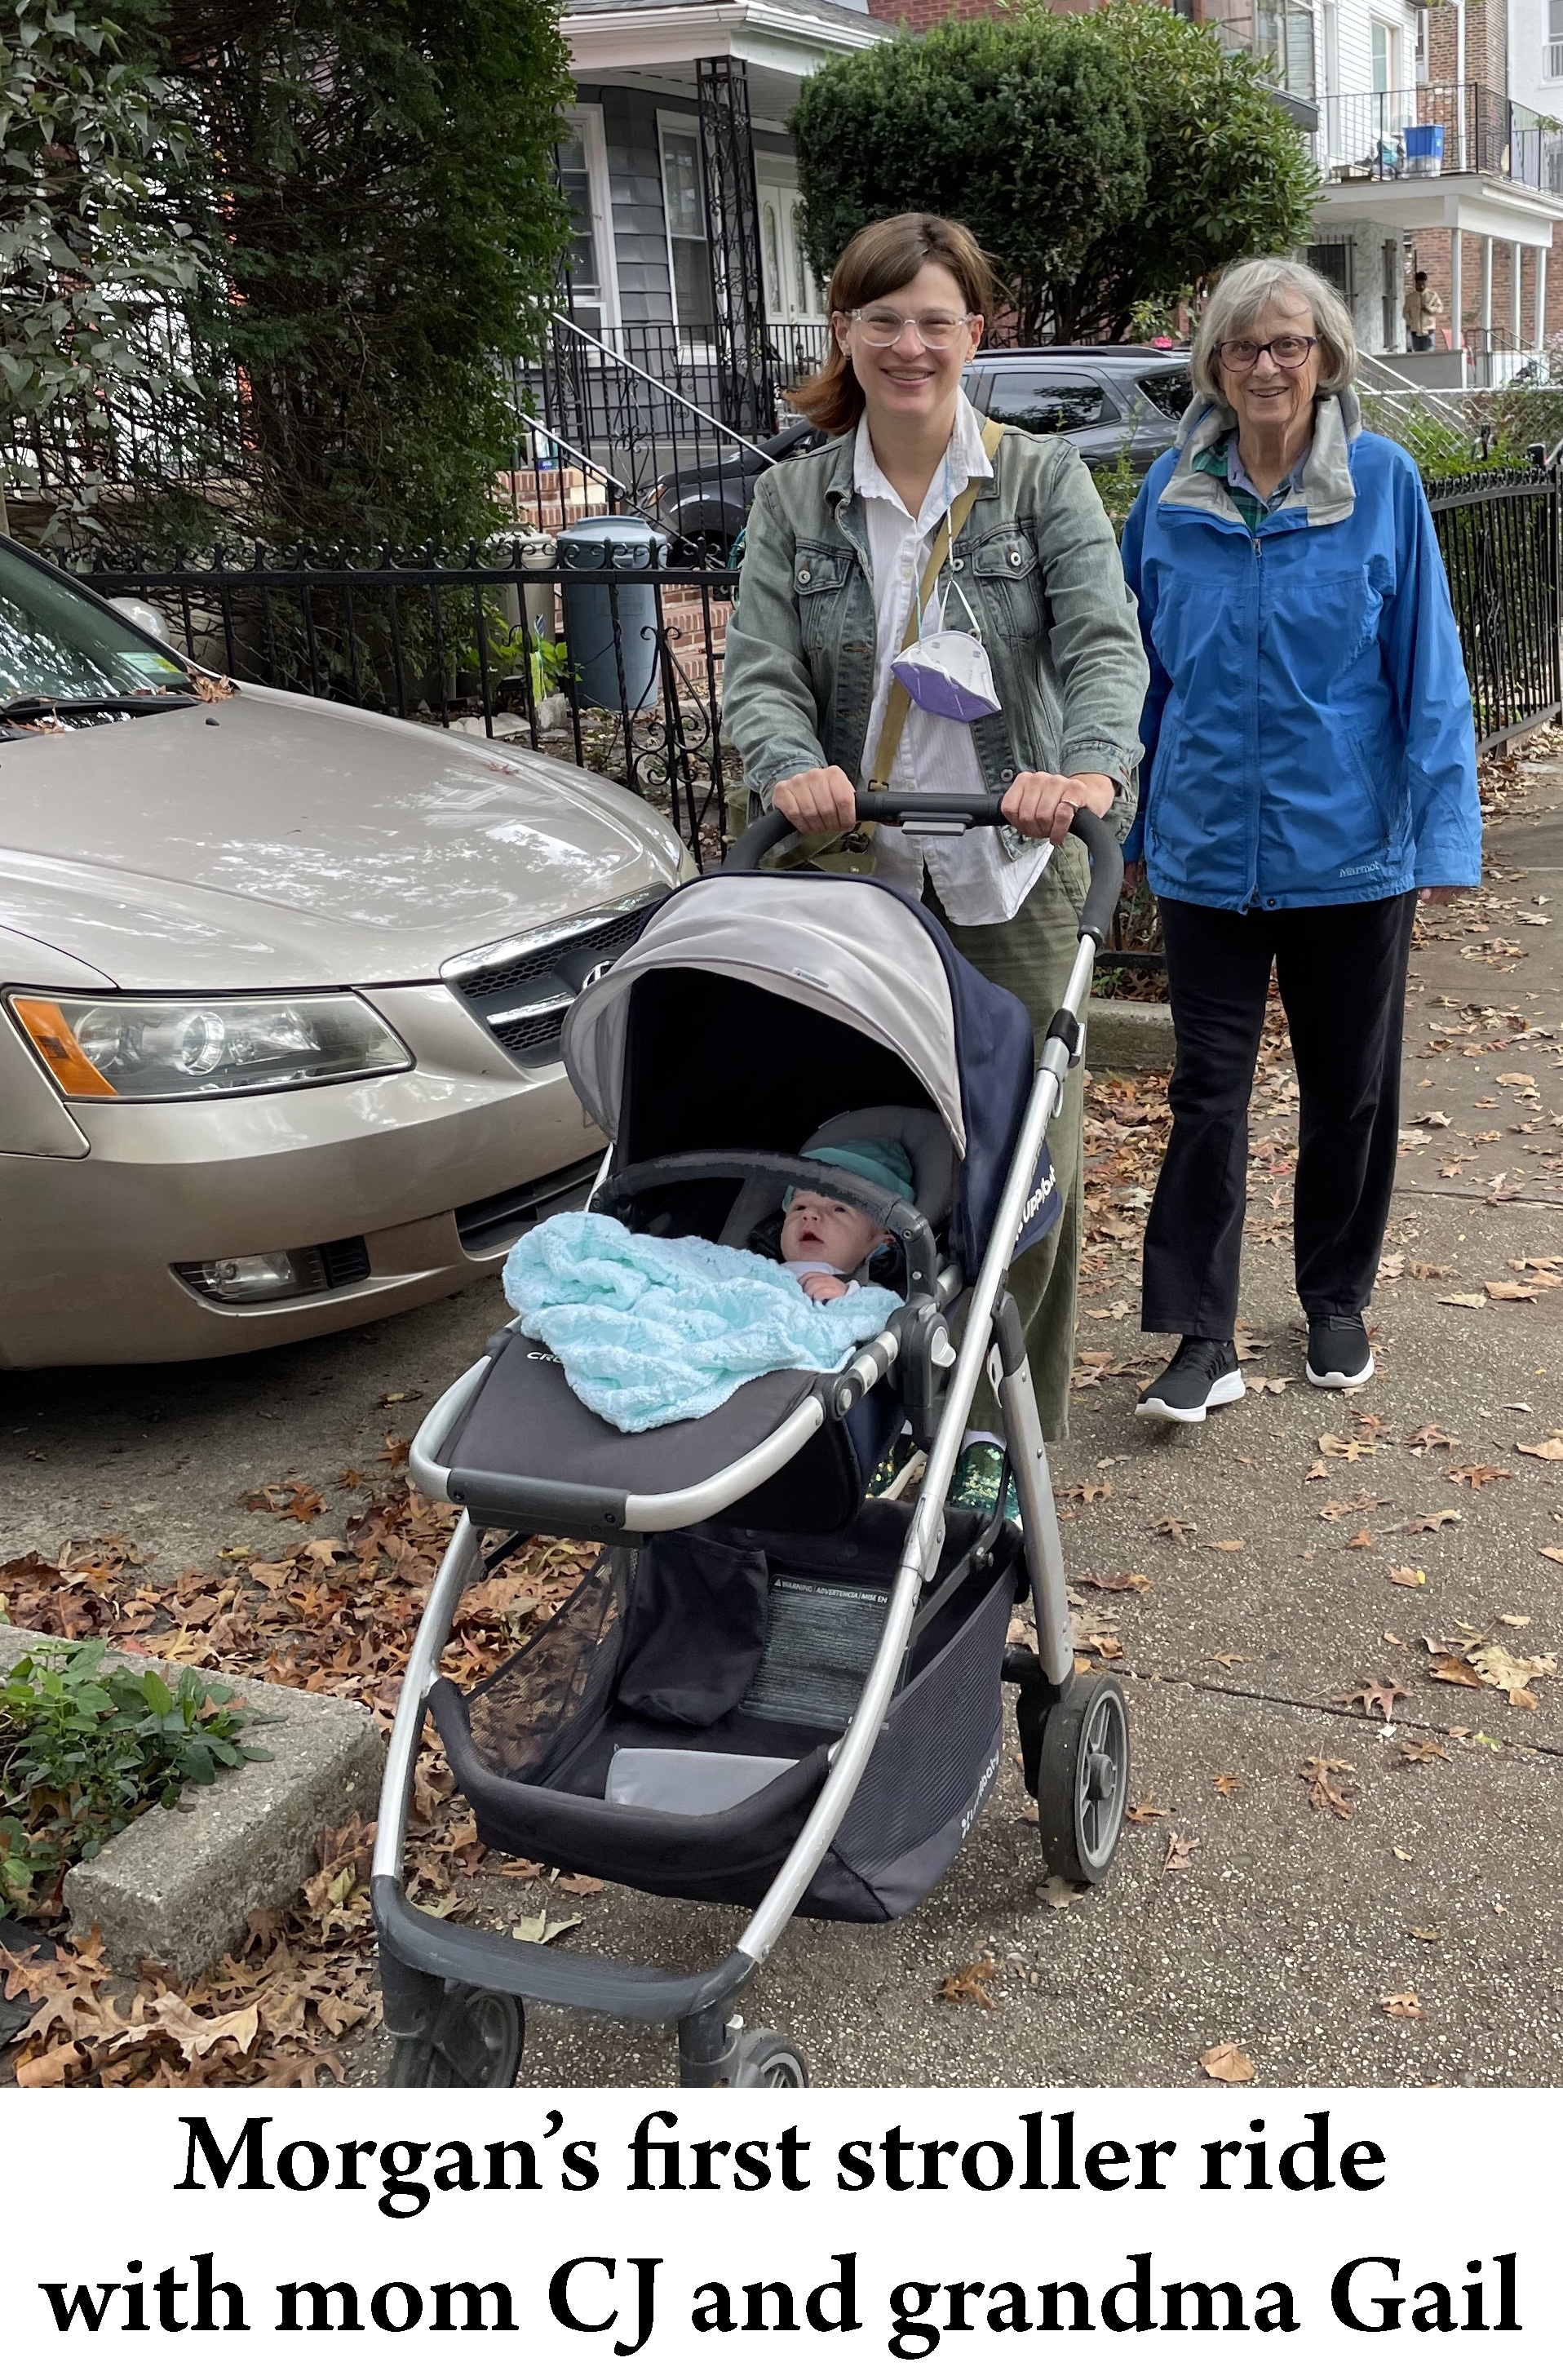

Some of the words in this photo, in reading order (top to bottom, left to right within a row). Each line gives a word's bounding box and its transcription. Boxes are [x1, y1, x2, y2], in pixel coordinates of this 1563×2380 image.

[1339, 860, 1380, 878] Marmot
[782, 1580, 813, 1593] WARNING
[816, 1587, 858, 1599] ADVERTENCIA
[877, 1595, 888, 1604] EN
